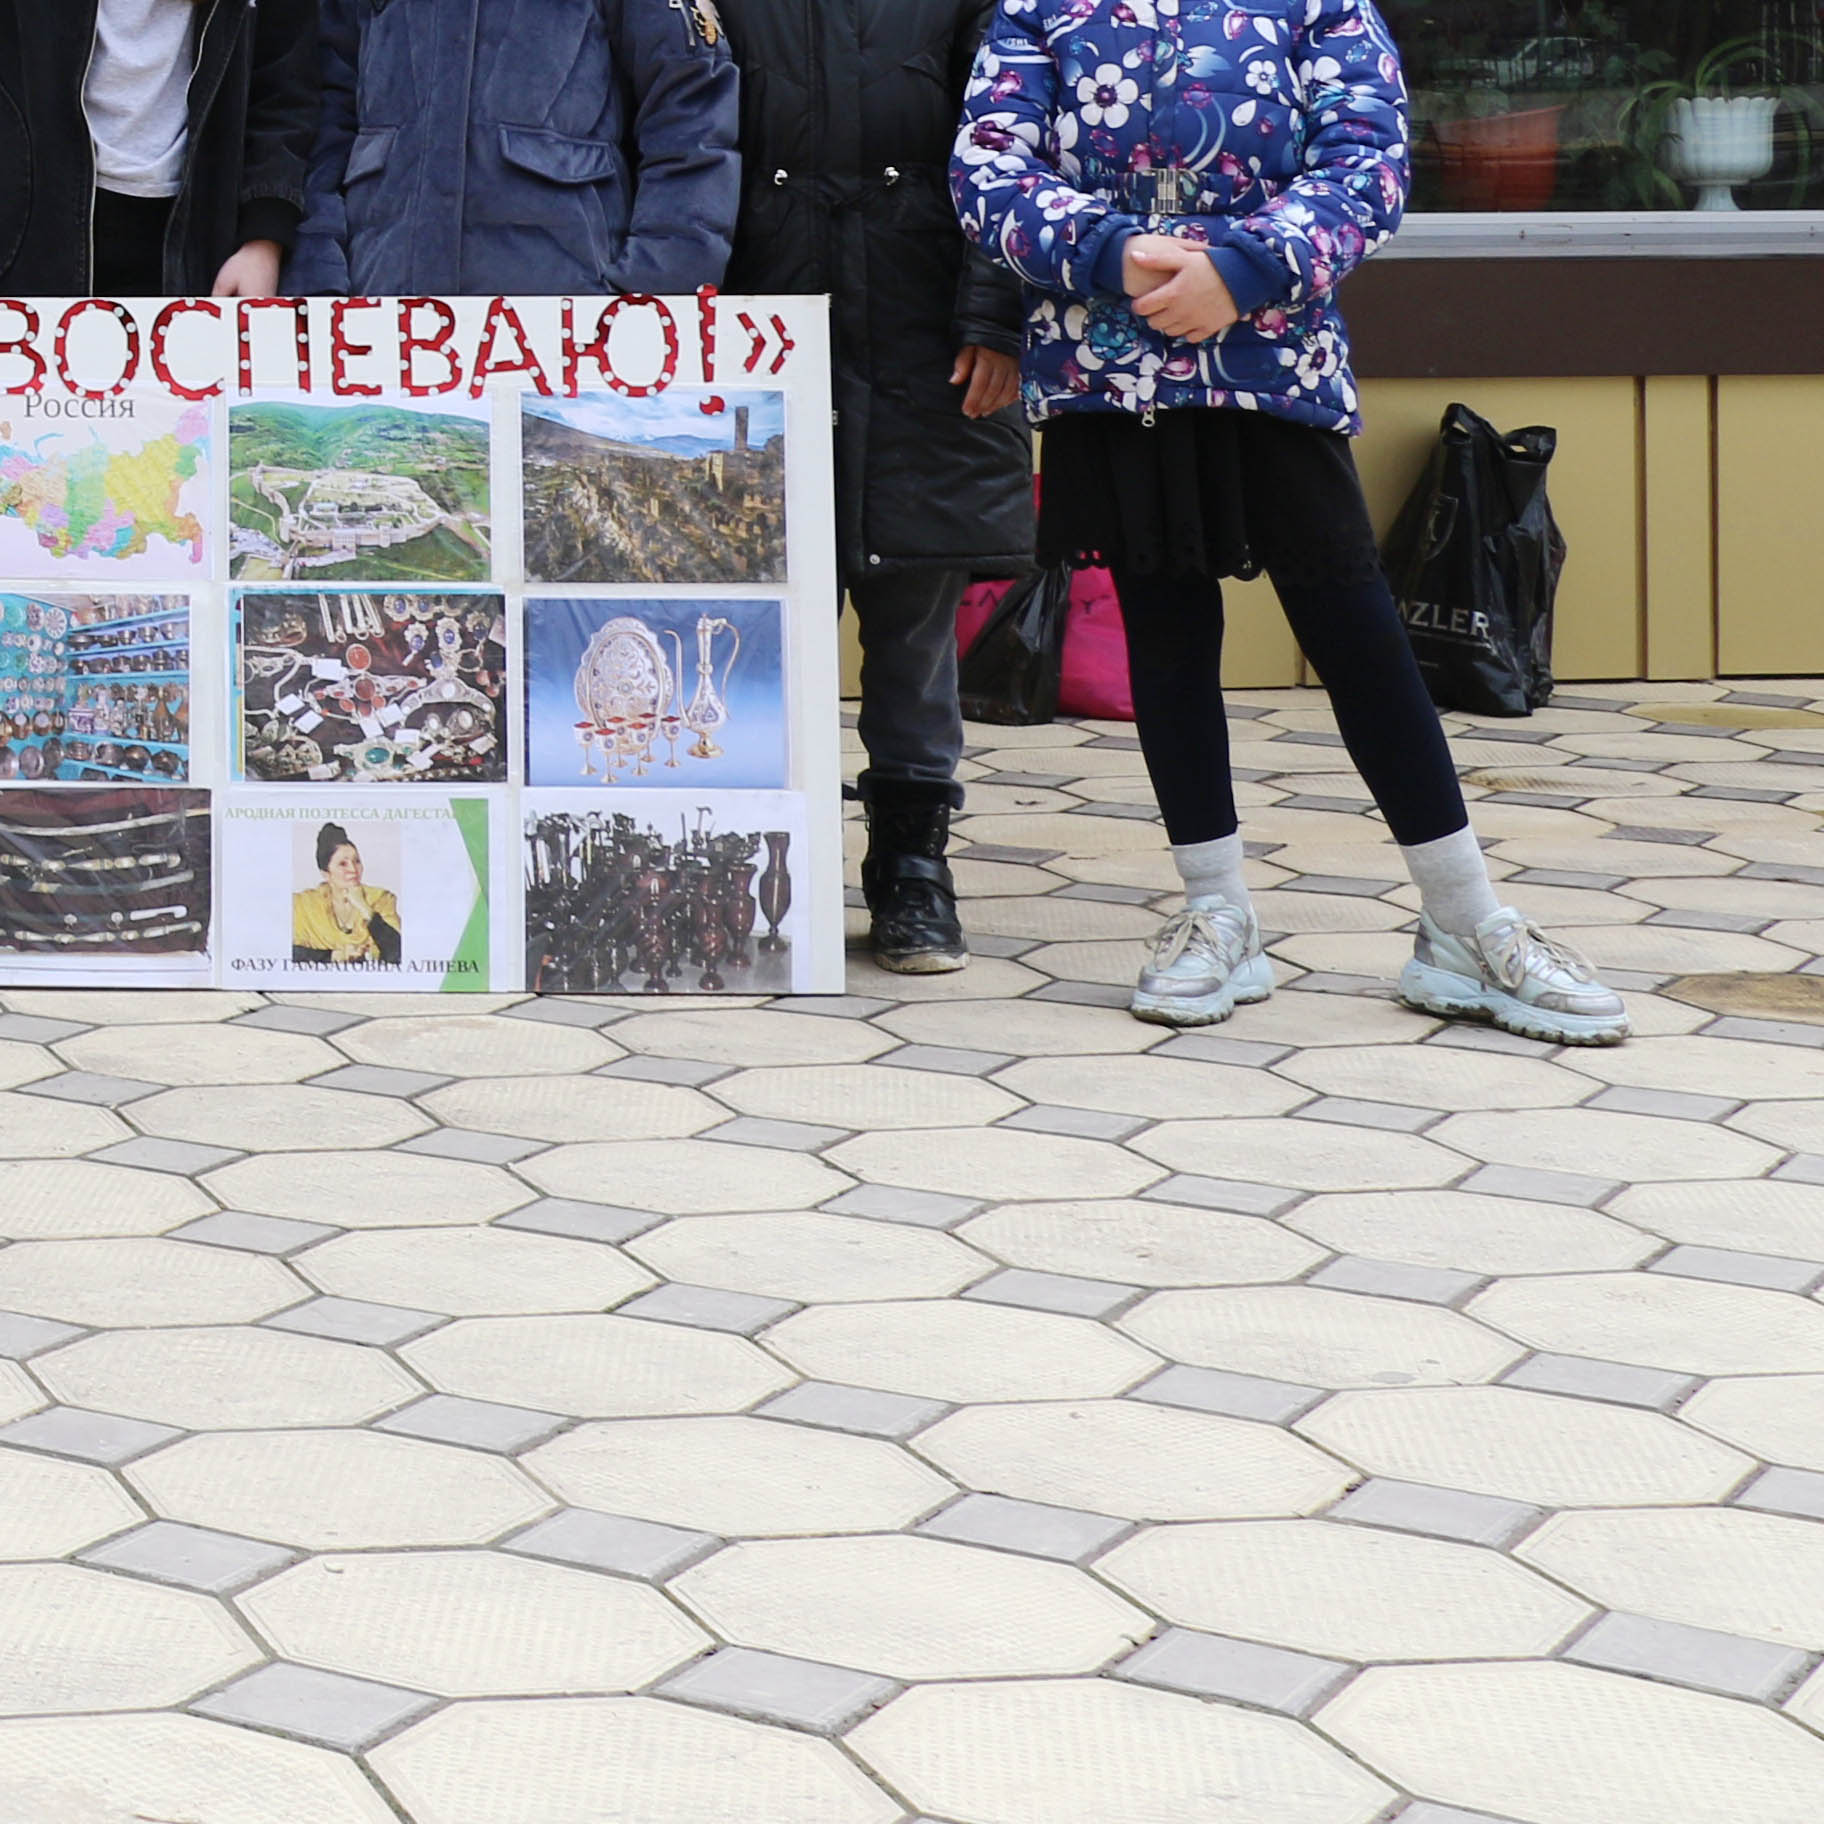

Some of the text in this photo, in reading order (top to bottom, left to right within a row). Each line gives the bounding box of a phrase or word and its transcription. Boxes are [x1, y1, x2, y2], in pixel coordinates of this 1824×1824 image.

[23, 390, 137, 418] Россия
[230, 958, 280, 973] ФАЗУ
[407, 959, 480, 974] АЛИЕВА
